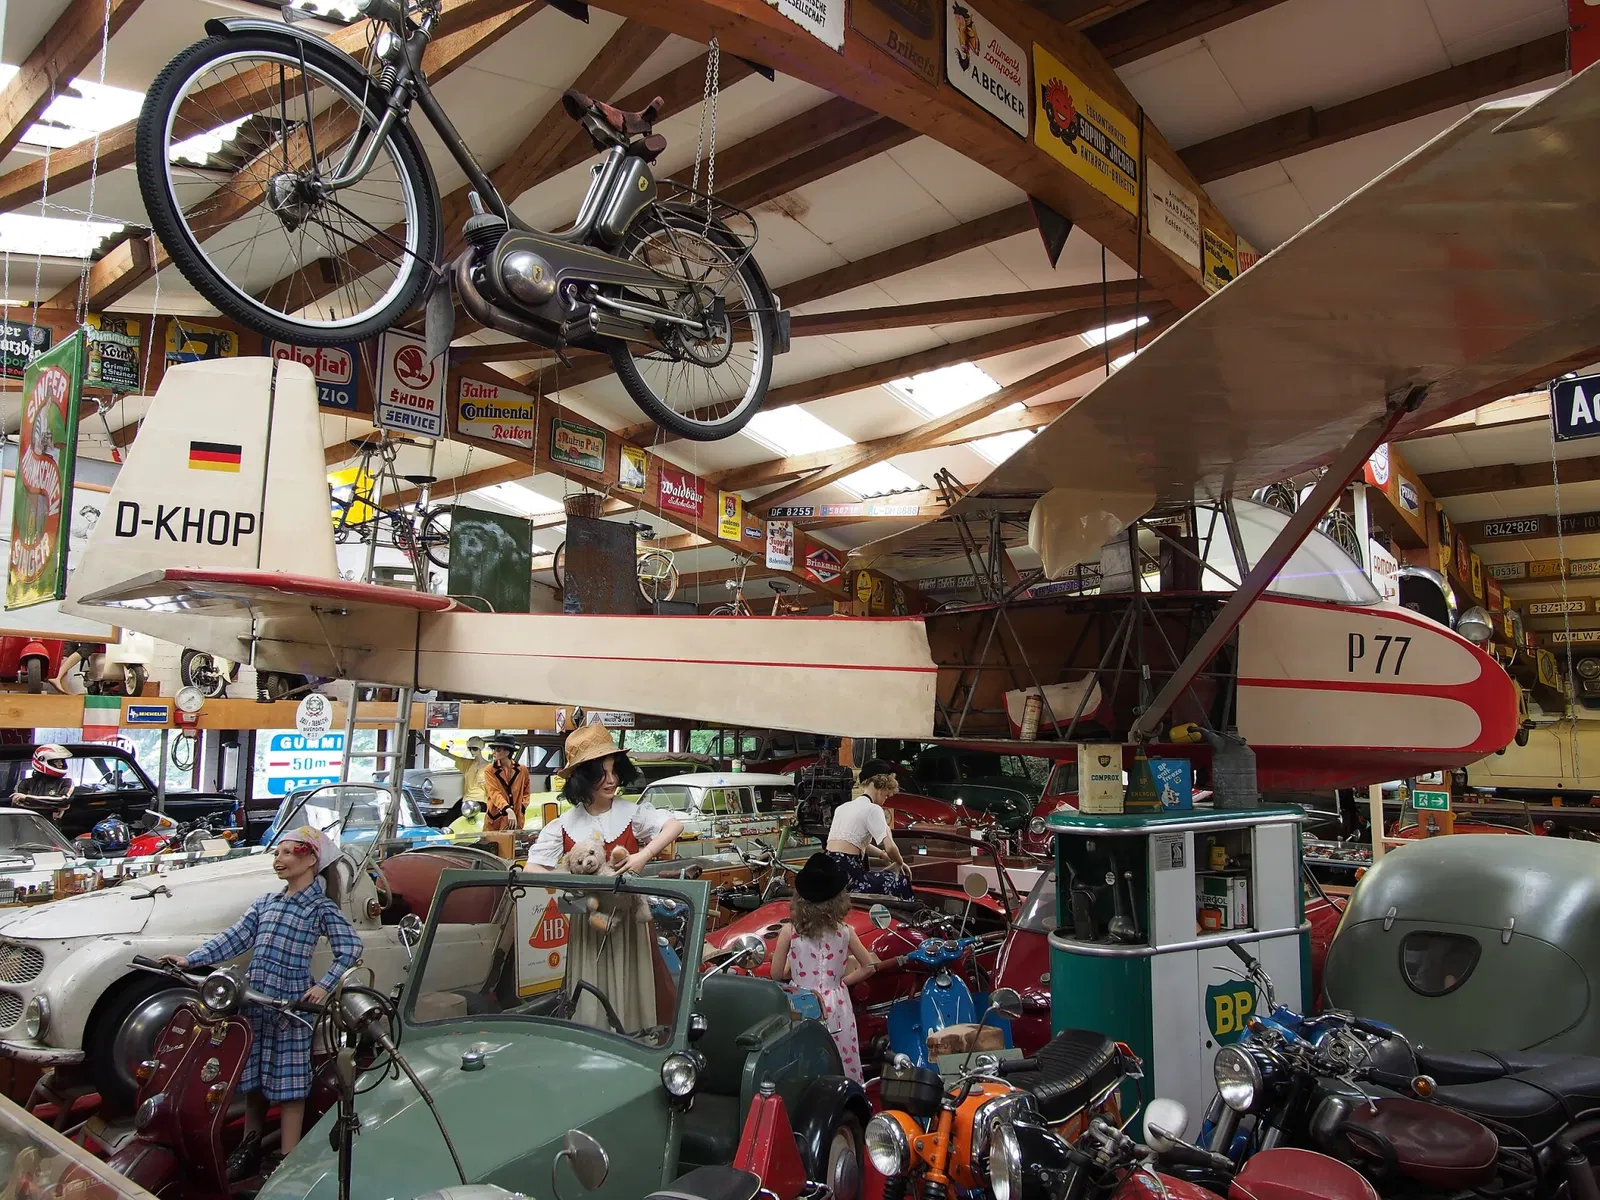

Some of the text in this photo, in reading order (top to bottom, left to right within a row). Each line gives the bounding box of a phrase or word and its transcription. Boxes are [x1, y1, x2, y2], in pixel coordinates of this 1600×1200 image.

[785, 0, 825, 28] ESELLSCHAFT
[987, 39, 1020, 72] Aliments
[971, 65, 1025, 119] A.BECKER
[1080, 117, 1135, 178] SOPHIA-JACOBA
[100, 343, 130, 360] Korn
[27, 366, 67, 424] SINGER
[462, 381, 499, 399] Fahrt
[386, 410, 435, 430] SERVICE
[461, 402, 533, 421] Continental
[491, 424, 532, 440] Reifen
[115, 500, 255, 546] D-KHOP
[771, 507, 811, 517] DF 8255
[13, 531, 50, 578] SINGER
[1348, 632, 1412, 675] P 77
[280, 736, 342, 749] GUMMI
[1157, 762, 1167, 771] BP
[1162, 768, 1183, 783] freeze
[543, 917, 565, 941] HB
[1212, 990, 1253, 1036] BP
